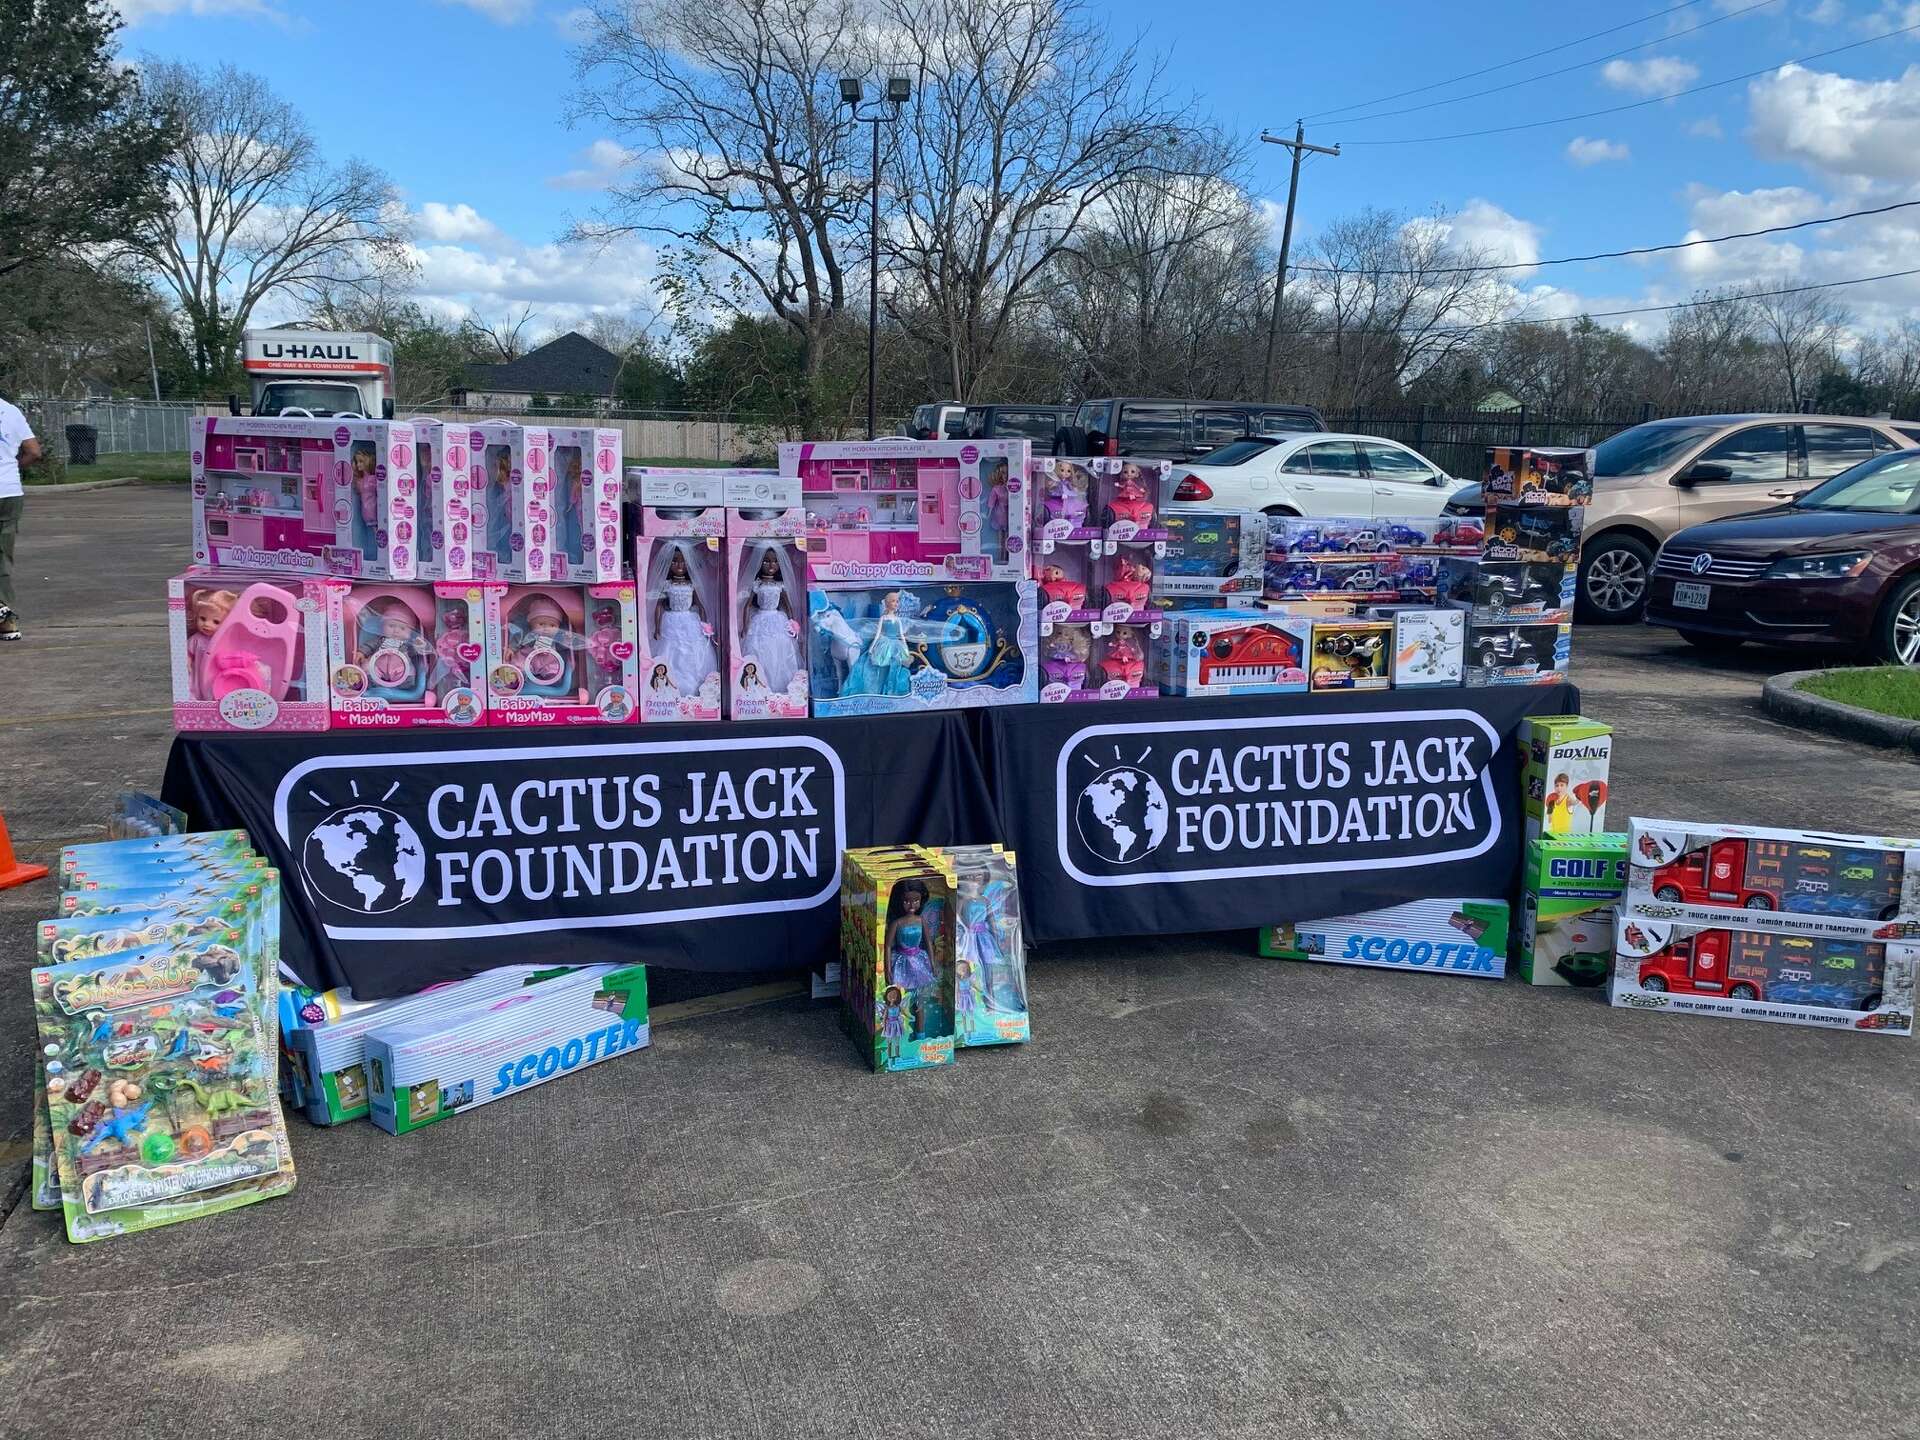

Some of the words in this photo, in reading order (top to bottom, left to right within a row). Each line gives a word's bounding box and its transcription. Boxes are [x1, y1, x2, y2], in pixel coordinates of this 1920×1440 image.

[263, 344, 358, 360] U-HAUL
[1048, 526, 1069, 534] BALANCE
[1112, 526, 1134, 534] BALANCE
[232, 550, 247, 564] My
[248, 550, 277, 566] happy
[278, 551, 314, 567] Kitchen
[832, 563, 849, 578] My
[850, 563, 888, 578] happy
[890, 562, 933, 576] Kitchen
[1046, 608, 1067, 616] BALANCE
[1108, 608, 1129, 616] BALANCE
[1044, 688, 1066, 696] BALANCE
[1104, 685, 1126, 694] BALANCE
[343, 699, 380, 712] Baby
[500, 698, 534, 710] Baby
[350, 713, 400, 725] MayMay
[506, 711, 556, 723] MayMay
[1554, 746, 1608, 760] BOXING
[1171, 741, 1351, 796] CACTUS
[1364, 736, 1477, 787] JACK
[428, 774, 660, 840] CACTUS
[678, 766, 818, 825] JACK
[1176, 788, 1476, 853] FOUNDATION
[436, 828, 820, 906] FOUNDATION
[1550, 858, 1609, 879] GOLF
[1688, 912, 1708, 920] TRUCK
[1814, 922, 1823, 930] DE
[1825, 924, 1867, 934] TRANSPORTE
[1342, 934, 1497, 972] SCOOTER
[1798, 1012, 1806, 1020] DE
[1808, 1014, 1850, 1024] TRANSPORTE
[253, 1015, 264, 1039] WORLD
[490, 1016, 641, 1096] SCOOTER
[140, 1186, 154, 1198] THE
[233, 1166, 258, 1176] WORLD
